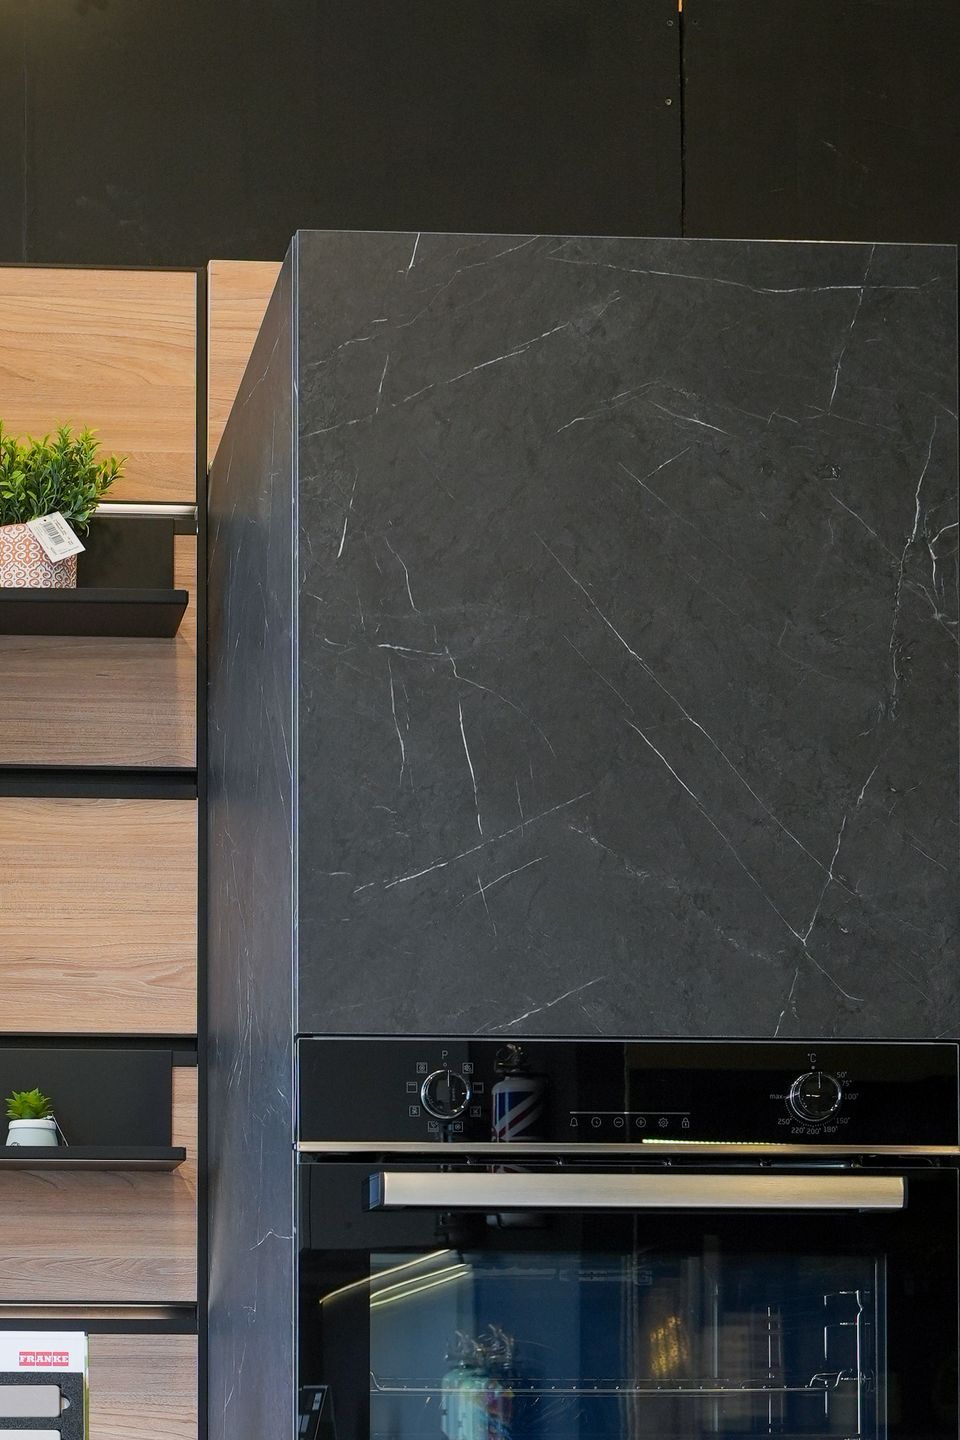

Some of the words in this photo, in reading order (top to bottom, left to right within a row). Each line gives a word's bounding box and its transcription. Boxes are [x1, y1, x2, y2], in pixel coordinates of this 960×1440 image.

[441, 1050, 449, 1060] P
[807, 1053, 817, 1063] °C
[836, 1071, 848, 1079] 50°
[791, 1126, 806, 1134] 220°
[806, 1127, 821, 1135] 200°
[823, 1125, 838, 1133] 180°
[19, 1354, 69, 1364] FRANKE
